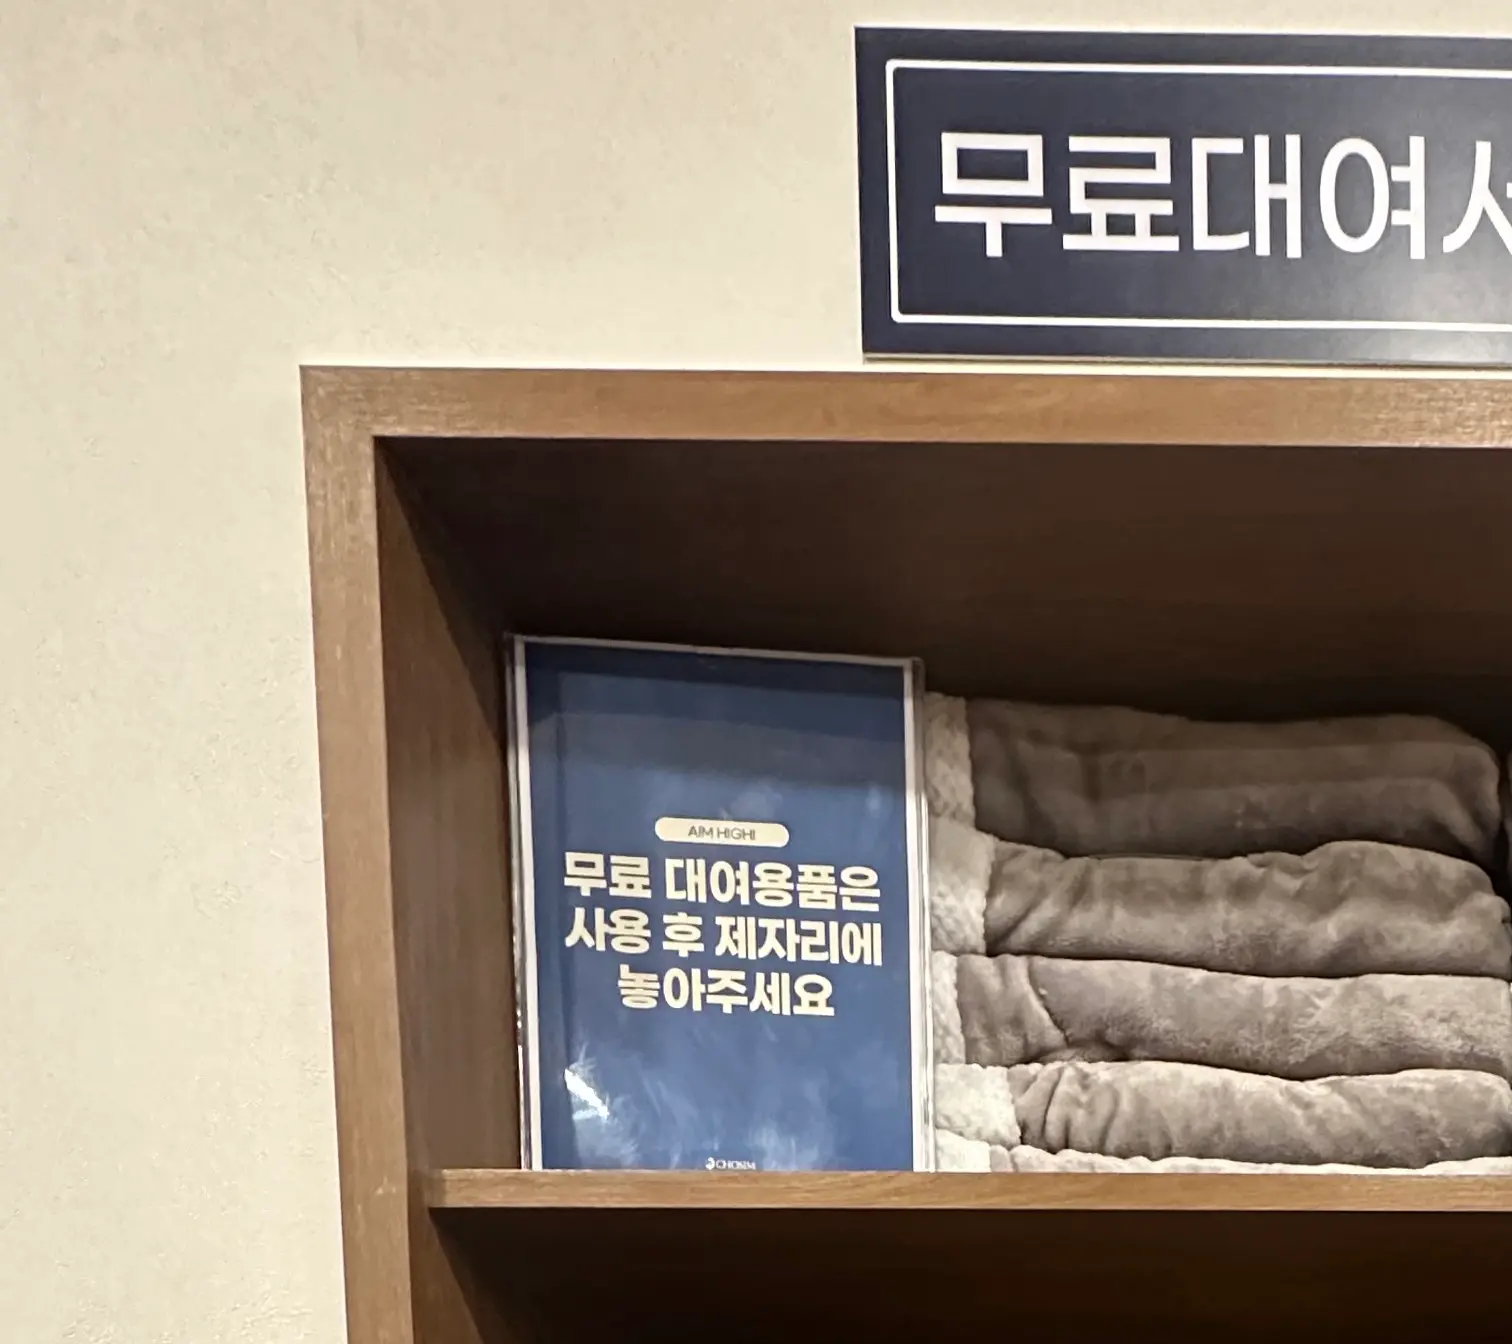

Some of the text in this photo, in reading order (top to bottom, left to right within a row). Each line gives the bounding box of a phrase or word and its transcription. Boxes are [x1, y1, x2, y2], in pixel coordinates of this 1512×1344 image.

[688, 825, 714, 839] AIM
[563, 851, 881, 912] 무료 대여용품은
[564, 906, 882, 967] 사용 후 제자리에
[618, 963, 835, 1017] 놓아주세요
